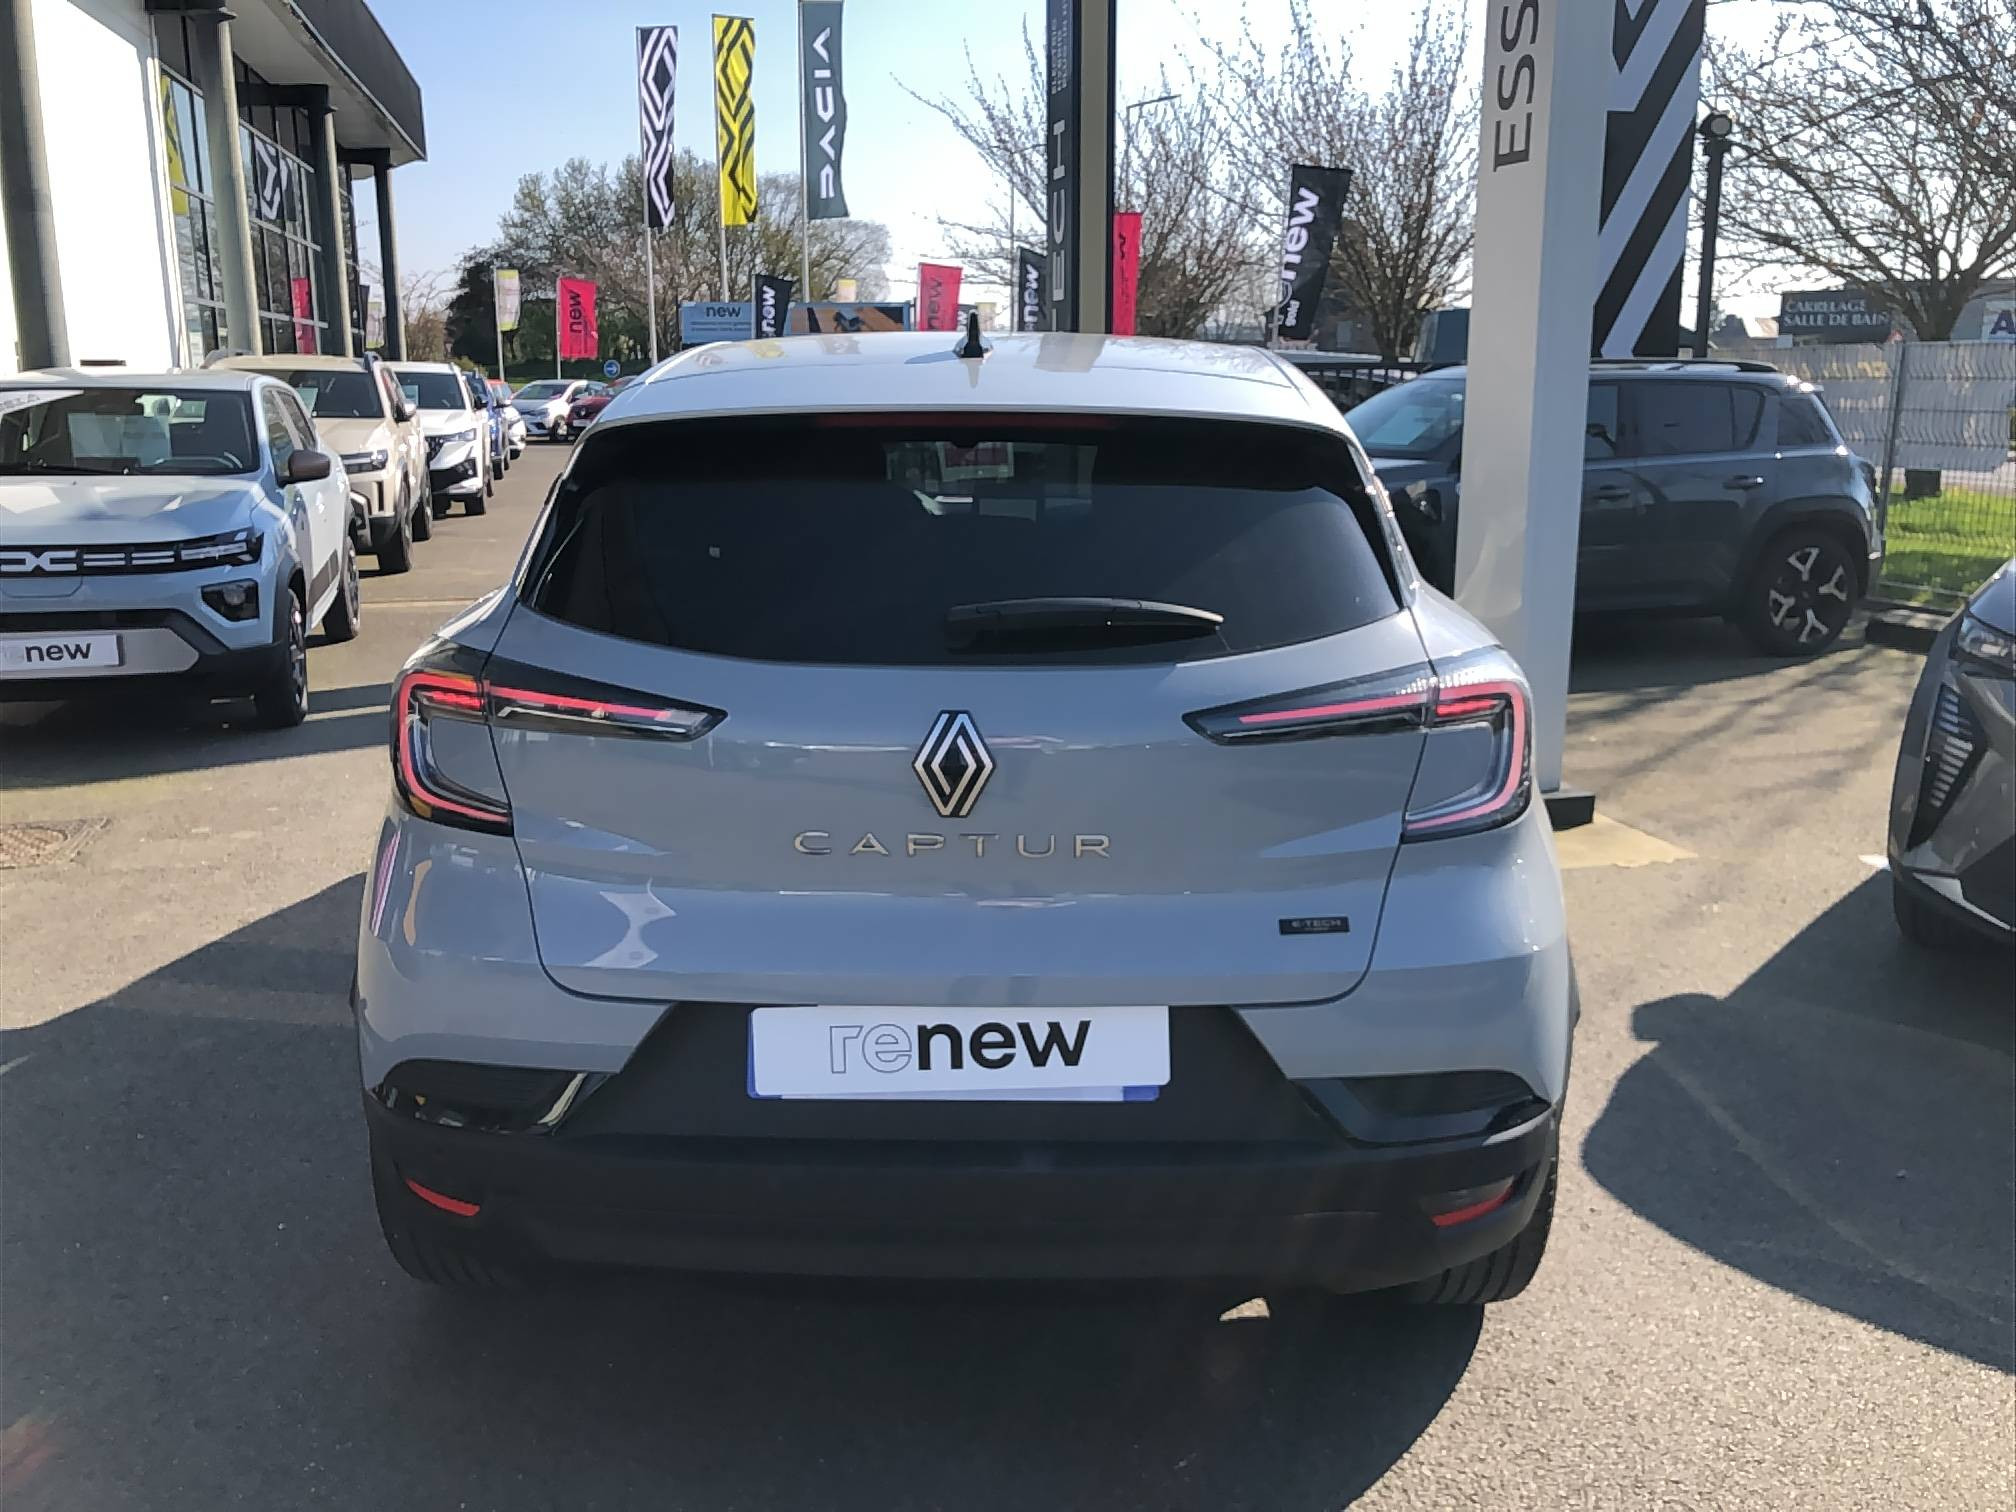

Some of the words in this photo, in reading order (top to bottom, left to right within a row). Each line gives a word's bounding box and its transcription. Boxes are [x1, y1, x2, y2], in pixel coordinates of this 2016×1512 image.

[812, 27, 836, 199] DACIA
[569, 289, 582, 334] new
[705, 305, 742, 318] new
[1784, 313, 1824, 327] SALLE
[1829, 313, 1848, 326] DE
[793, 830, 1112, 858] CAPTUR
[1291, 918, 1341, 929] E-TECH
[829, 1019, 1091, 1074] renew
